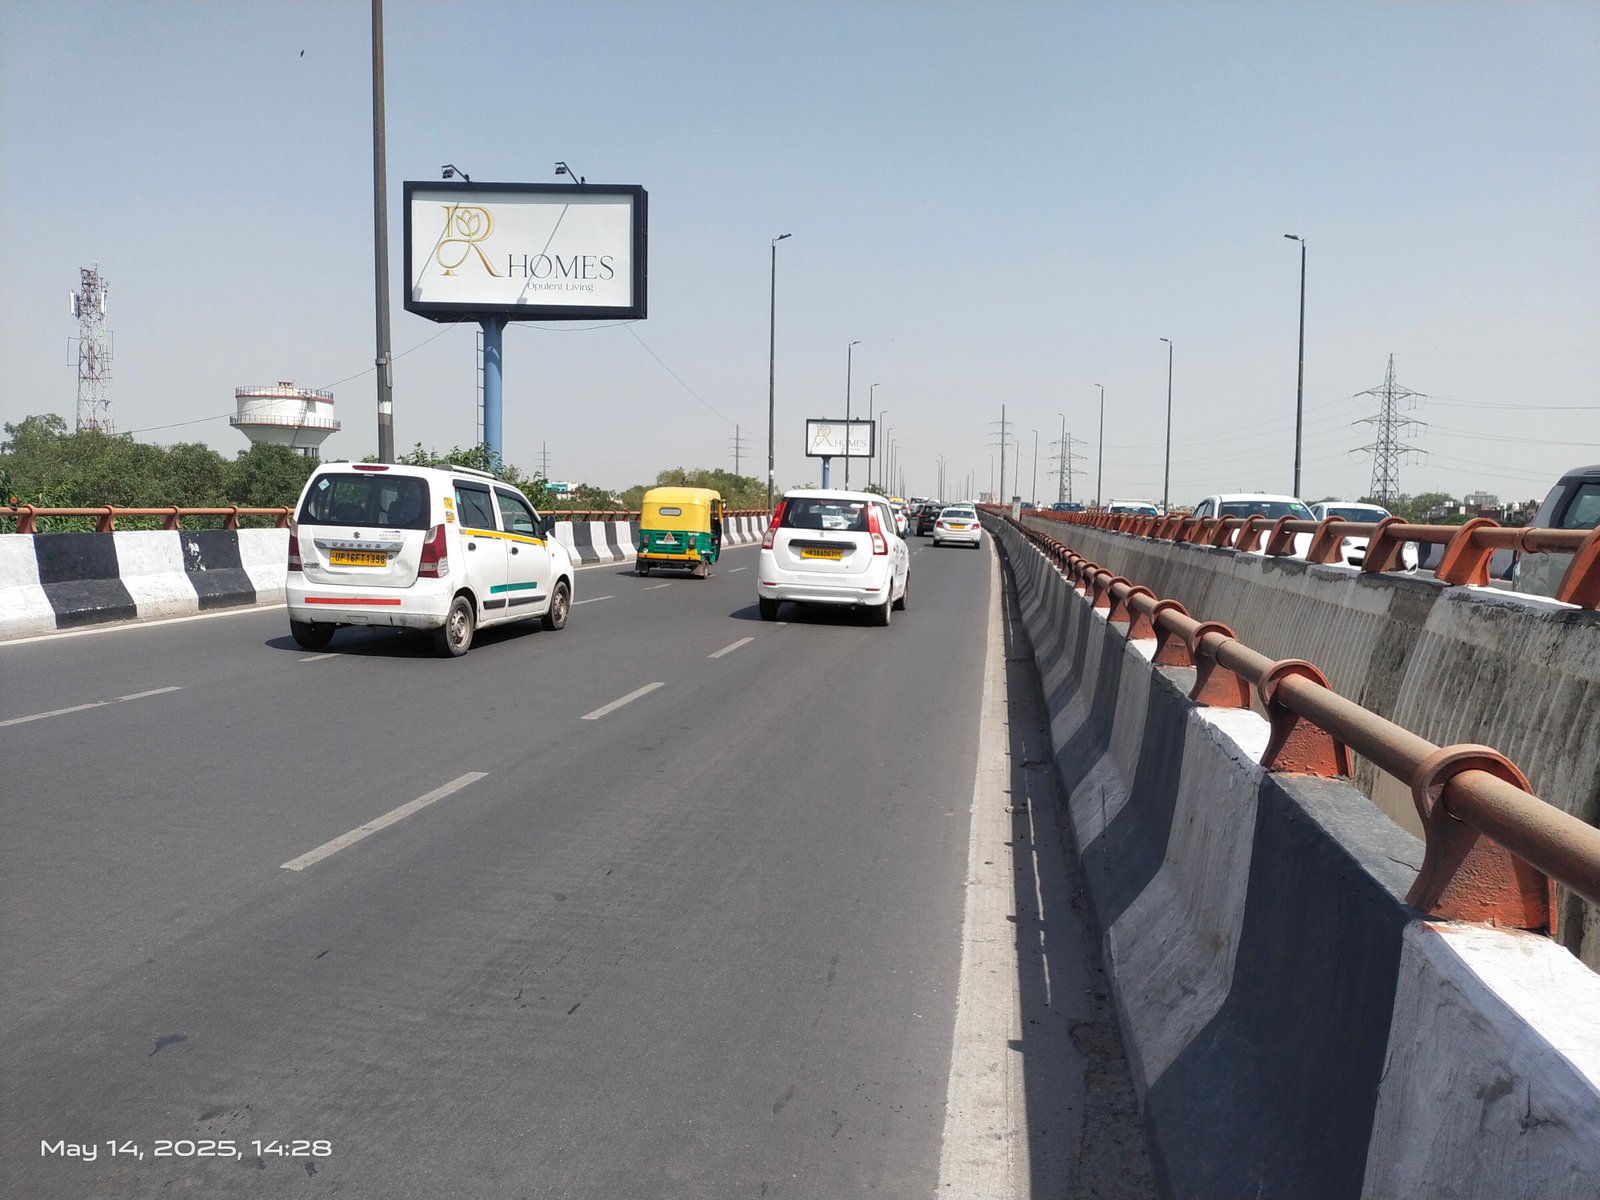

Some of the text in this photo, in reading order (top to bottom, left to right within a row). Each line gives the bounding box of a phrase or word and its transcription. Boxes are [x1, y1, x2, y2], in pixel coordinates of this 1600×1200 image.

[508, 254, 614, 280] HOMES
[527, 282, 593, 292] Opulent Living
[335, 552, 385, 565] UP16FT1398
